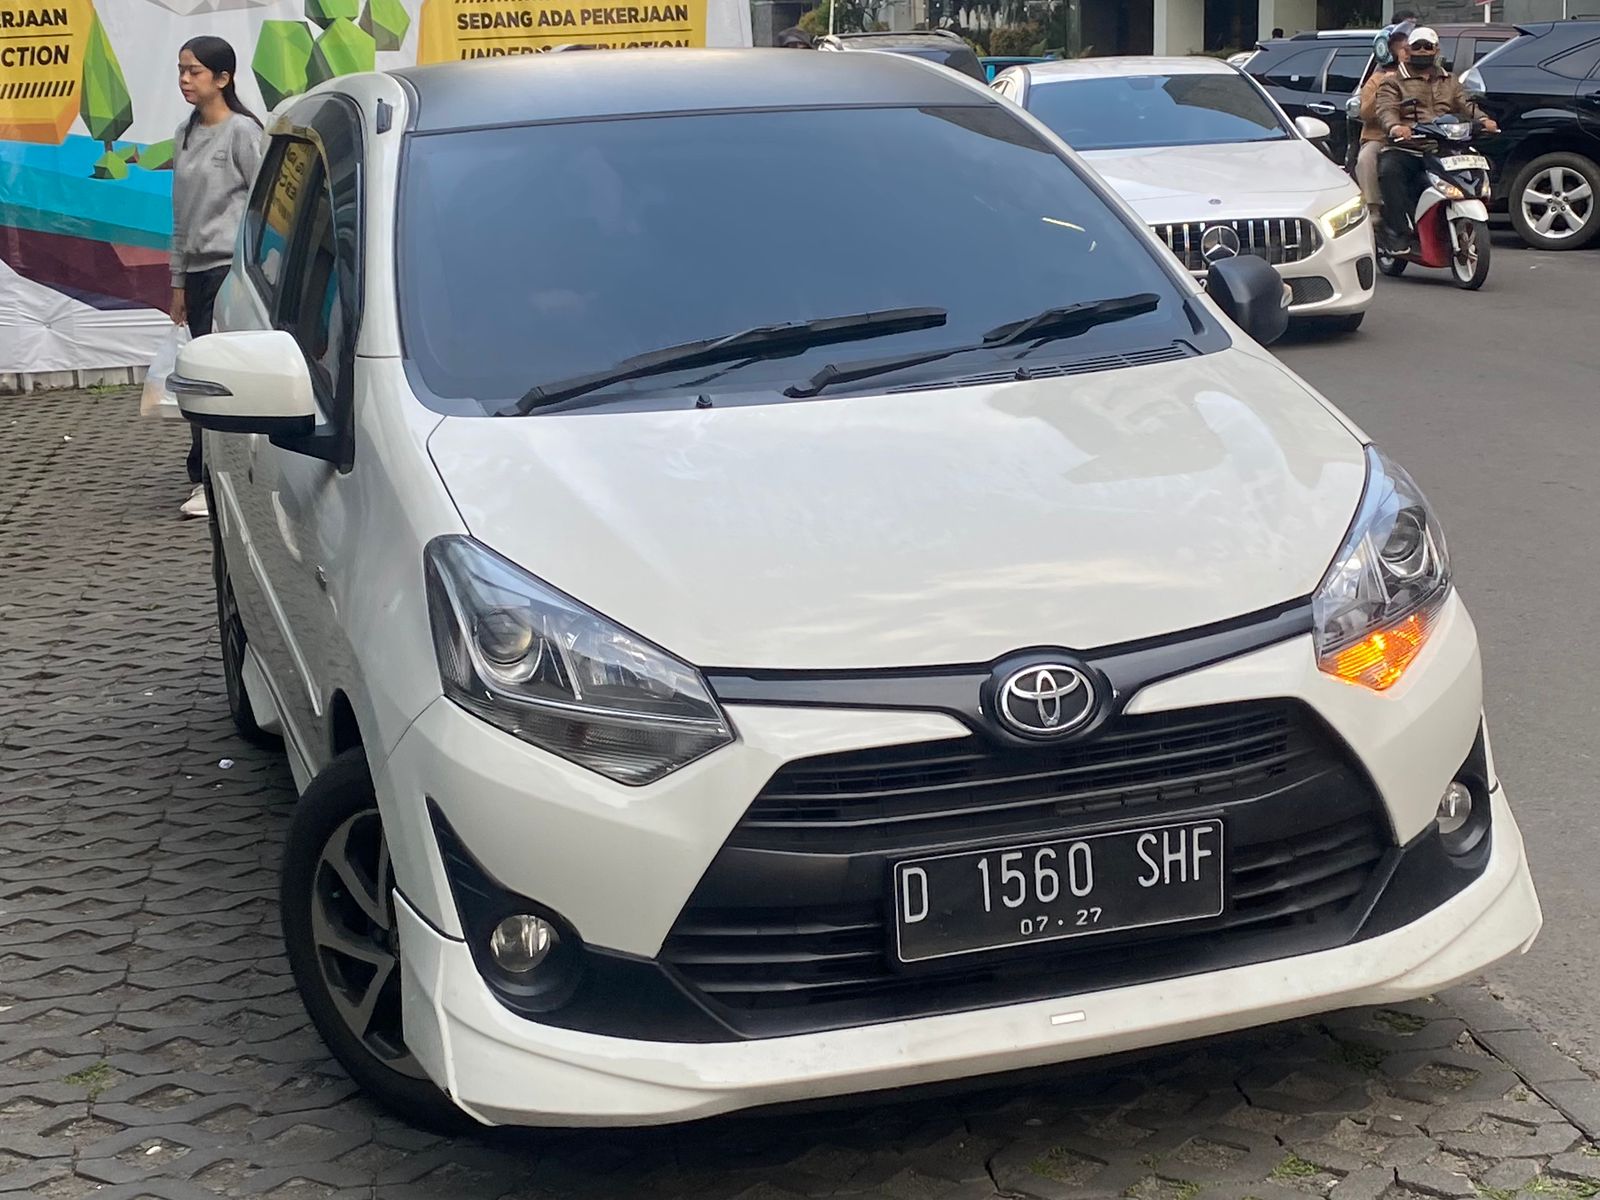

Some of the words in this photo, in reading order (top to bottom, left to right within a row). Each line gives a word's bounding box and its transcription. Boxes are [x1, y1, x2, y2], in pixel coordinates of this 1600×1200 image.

[0, 8, 68, 28] RJAAN
[457, 10, 533, 30] SEDANG
[537, 9, 576, 27] ADA
[580, 4, 689, 25] PEKERJAAN
[902, 867, 929, 923] D
[977, 841, 1094, 912] 1560
[1136, 827, 1214, 887] SHF
